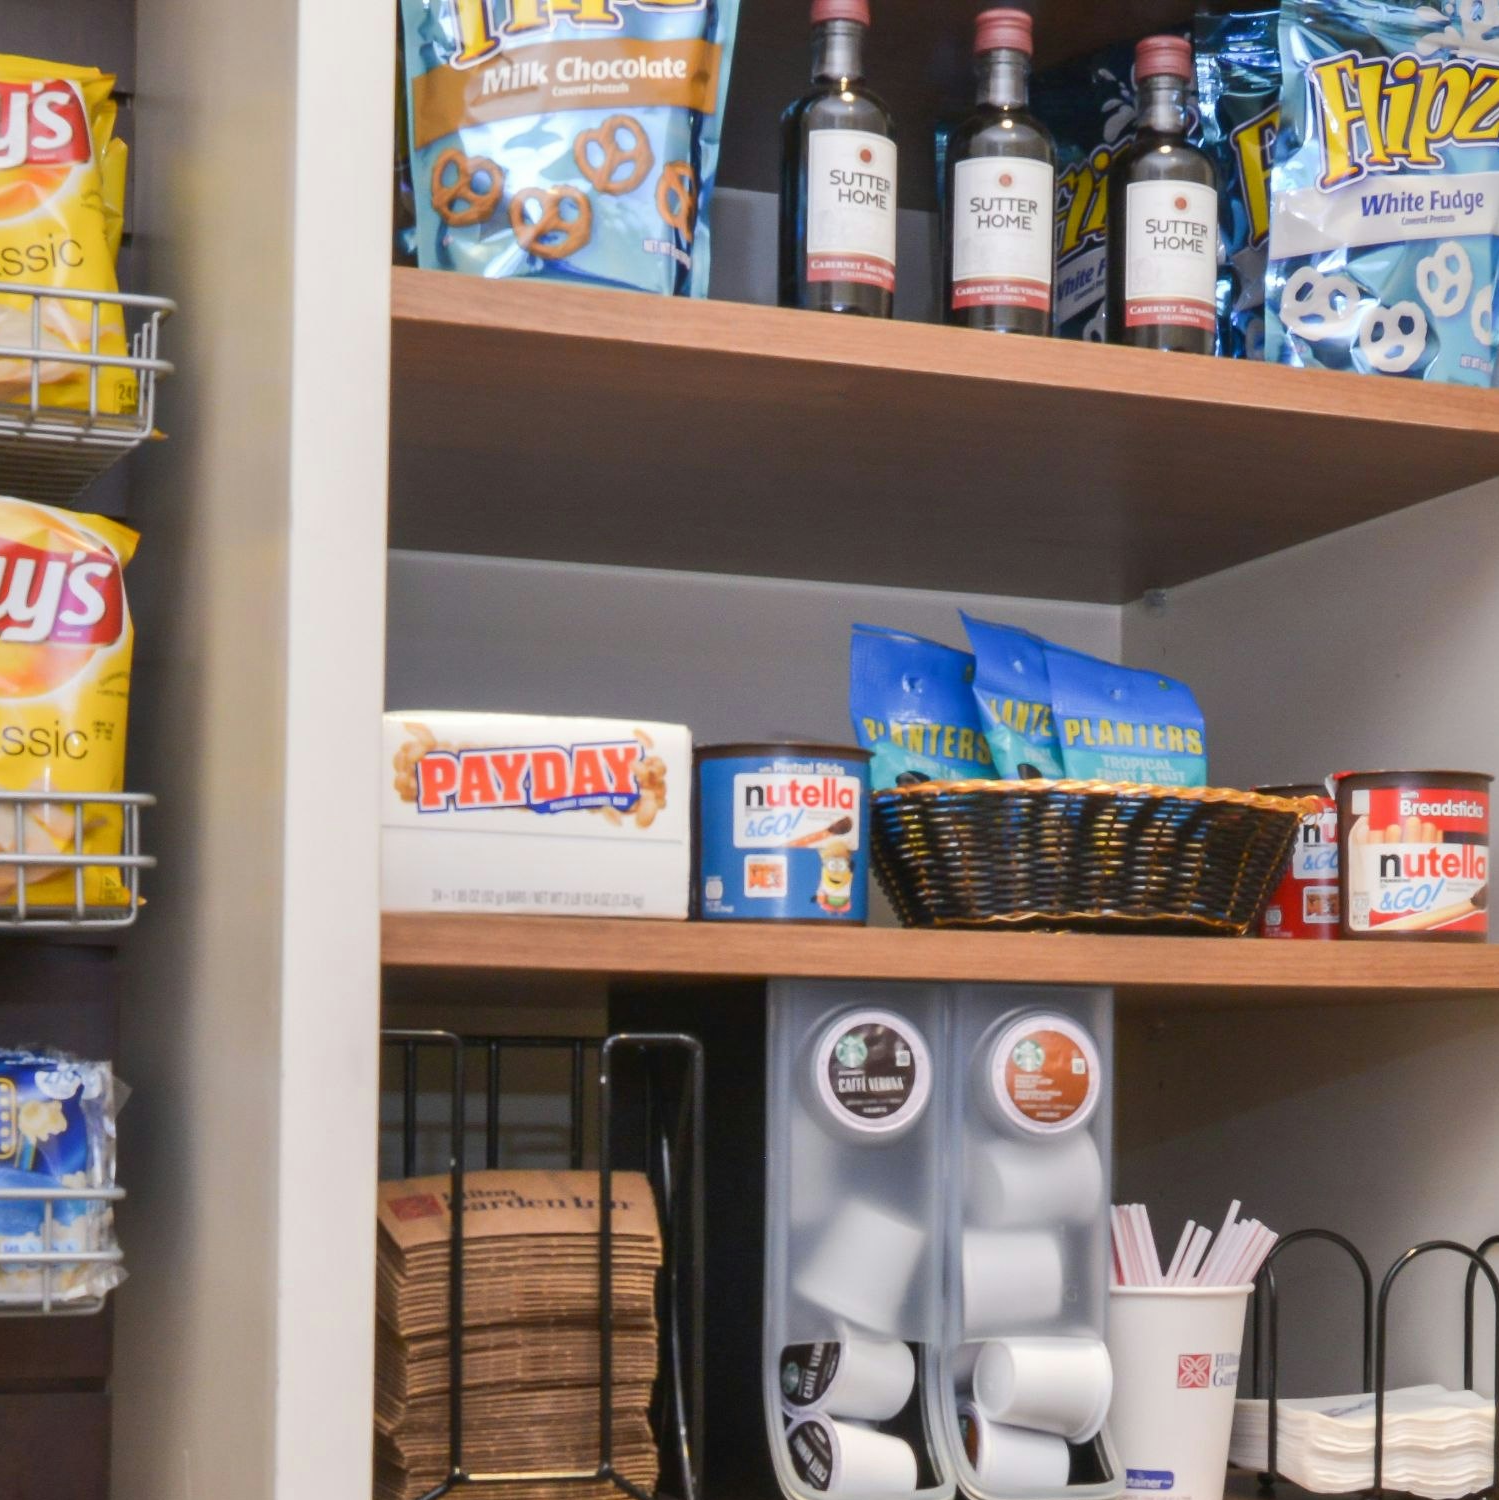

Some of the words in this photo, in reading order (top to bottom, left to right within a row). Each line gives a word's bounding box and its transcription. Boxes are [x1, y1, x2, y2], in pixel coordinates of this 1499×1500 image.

[482, 61, 548, 94] Milk
[556, 56, 687, 82] Chocolate
[552, 86, 589, 96] Covered
[593, 84, 629, 95] Pretzels
[830, 170, 890, 193] SUTTER
[839, 189, 886, 210] HOME
[970, 198, 1037, 215] SUTTER
[1362, 192, 1424, 216] White
[1430, 190, 1483, 215] Fudge
[978, 214, 1031, 230] HOME
[1146, 219, 1208, 238] SUTTER
[1402, 216, 1428, 225] Covered
[1430, 215, 1455, 224] Pretzels
[1153, 237, 1204, 253] HOME
[956, 286, 1000, 295] CABERNET
[1130, 306, 1176, 314] CABERNET
[863, 718, 991, 764] PANTERS
[1065, 719, 1203, 755] PLANTERS
[1103, 757, 1173, 771] TROPICAL
[419, 747, 638, 806] PAYDAY
[745, 778, 853, 809] nutella
[1400, 799, 1484, 819] Breadsticks
[745, 809, 804, 837] &GO!
[1380, 844, 1486, 879] nutella
[1381, 879, 1445, 910] &GO!
